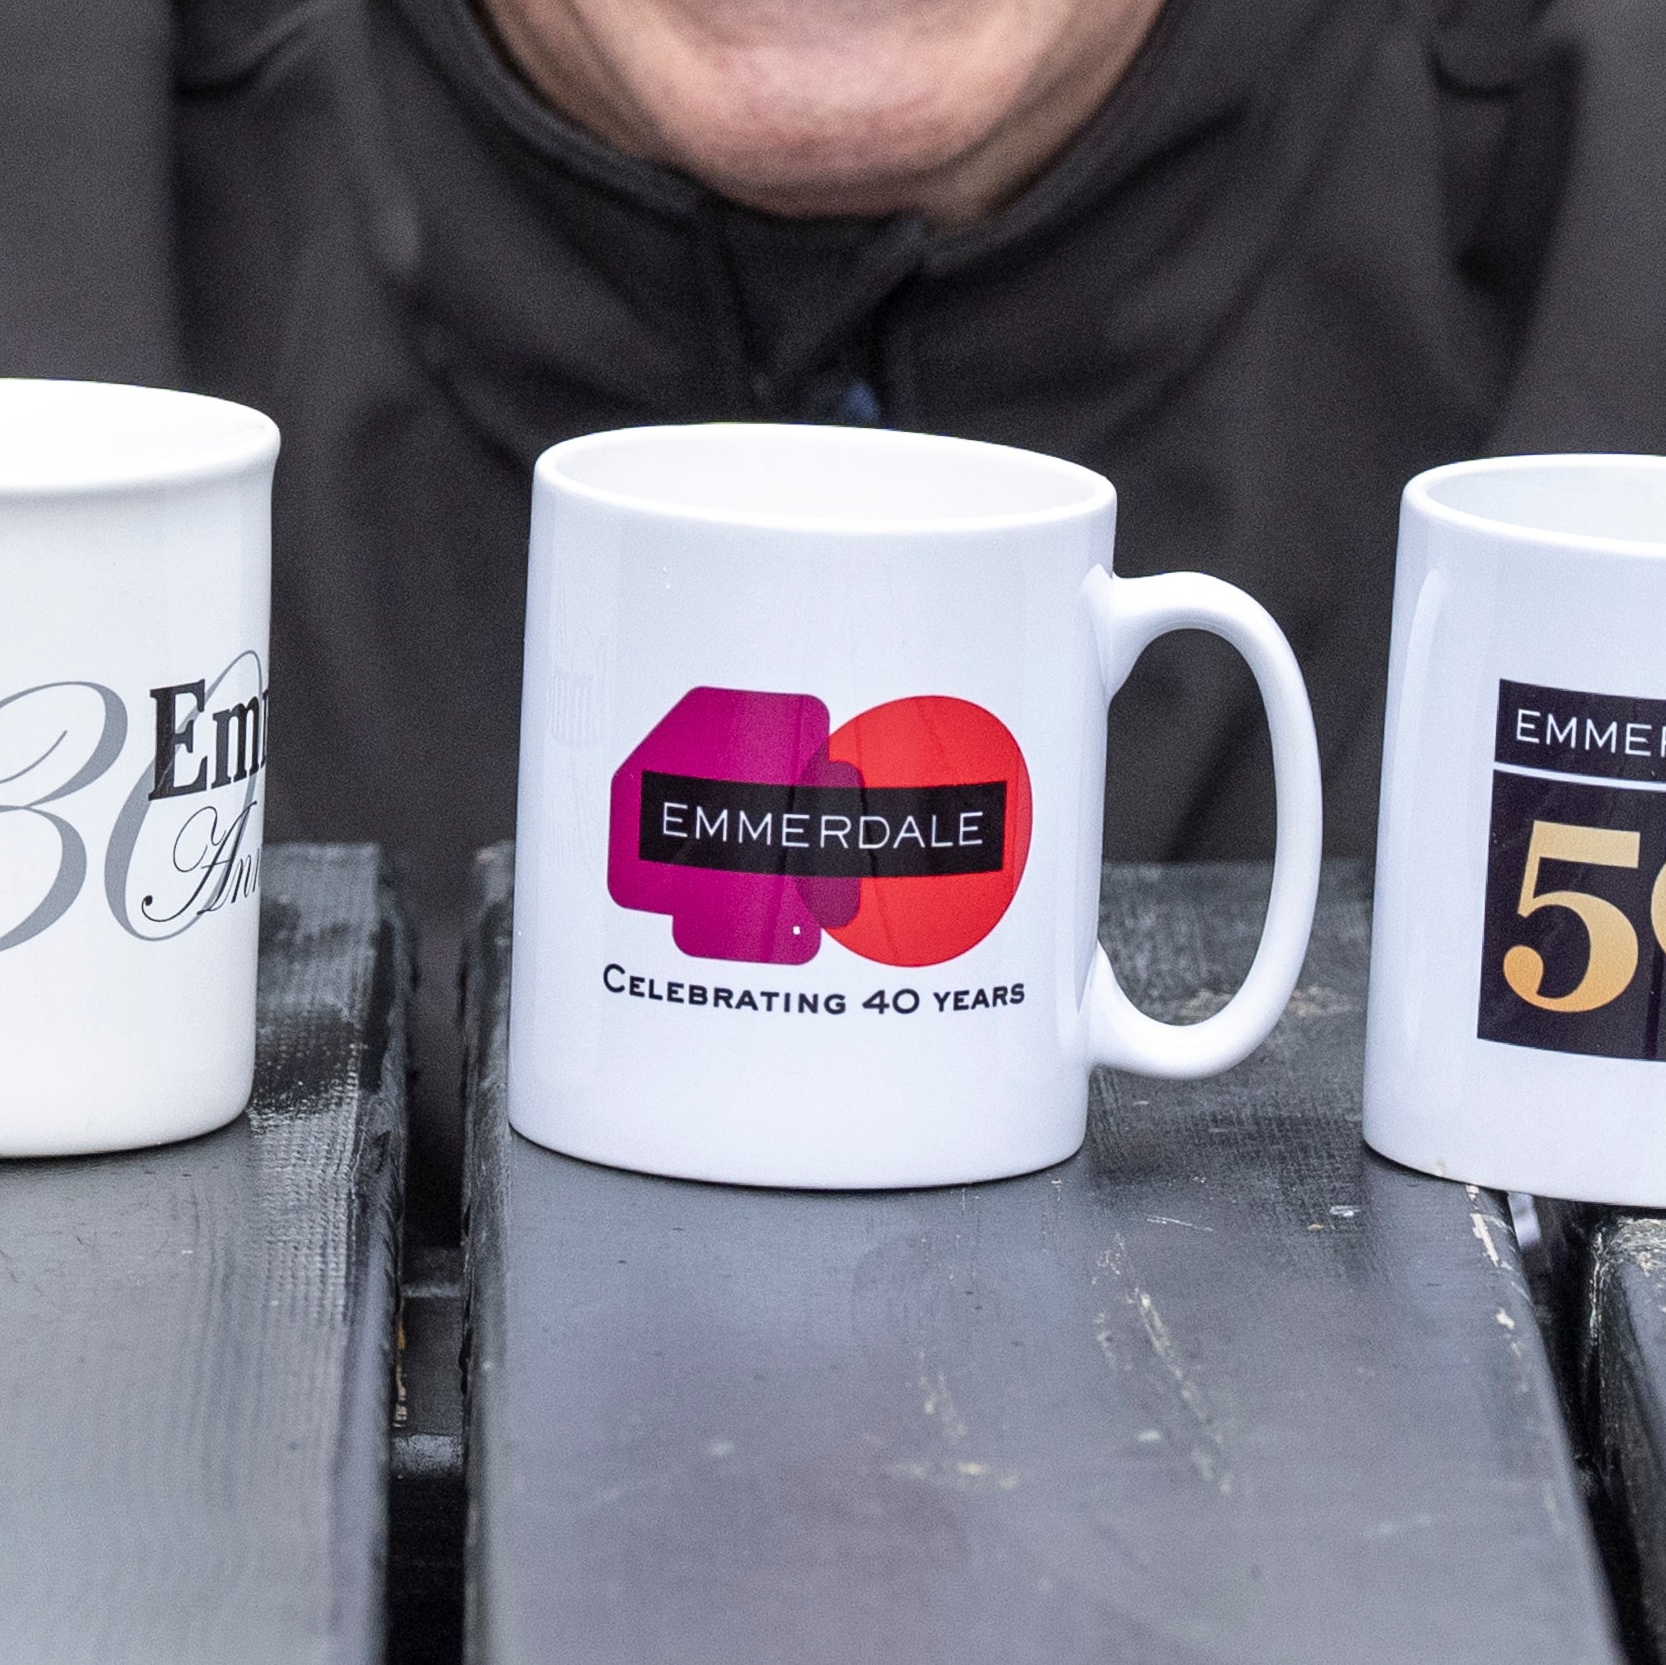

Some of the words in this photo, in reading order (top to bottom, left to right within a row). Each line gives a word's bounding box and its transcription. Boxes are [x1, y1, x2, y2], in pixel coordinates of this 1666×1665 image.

[148, 678, 269, 801] Em
[662, 801, 985, 849] EMMERDALE
[602, 962, 847, 1016] CELEBRATING
[861, 987, 921, 1015] 40
[932, 982, 1026, 1013] YEARS
